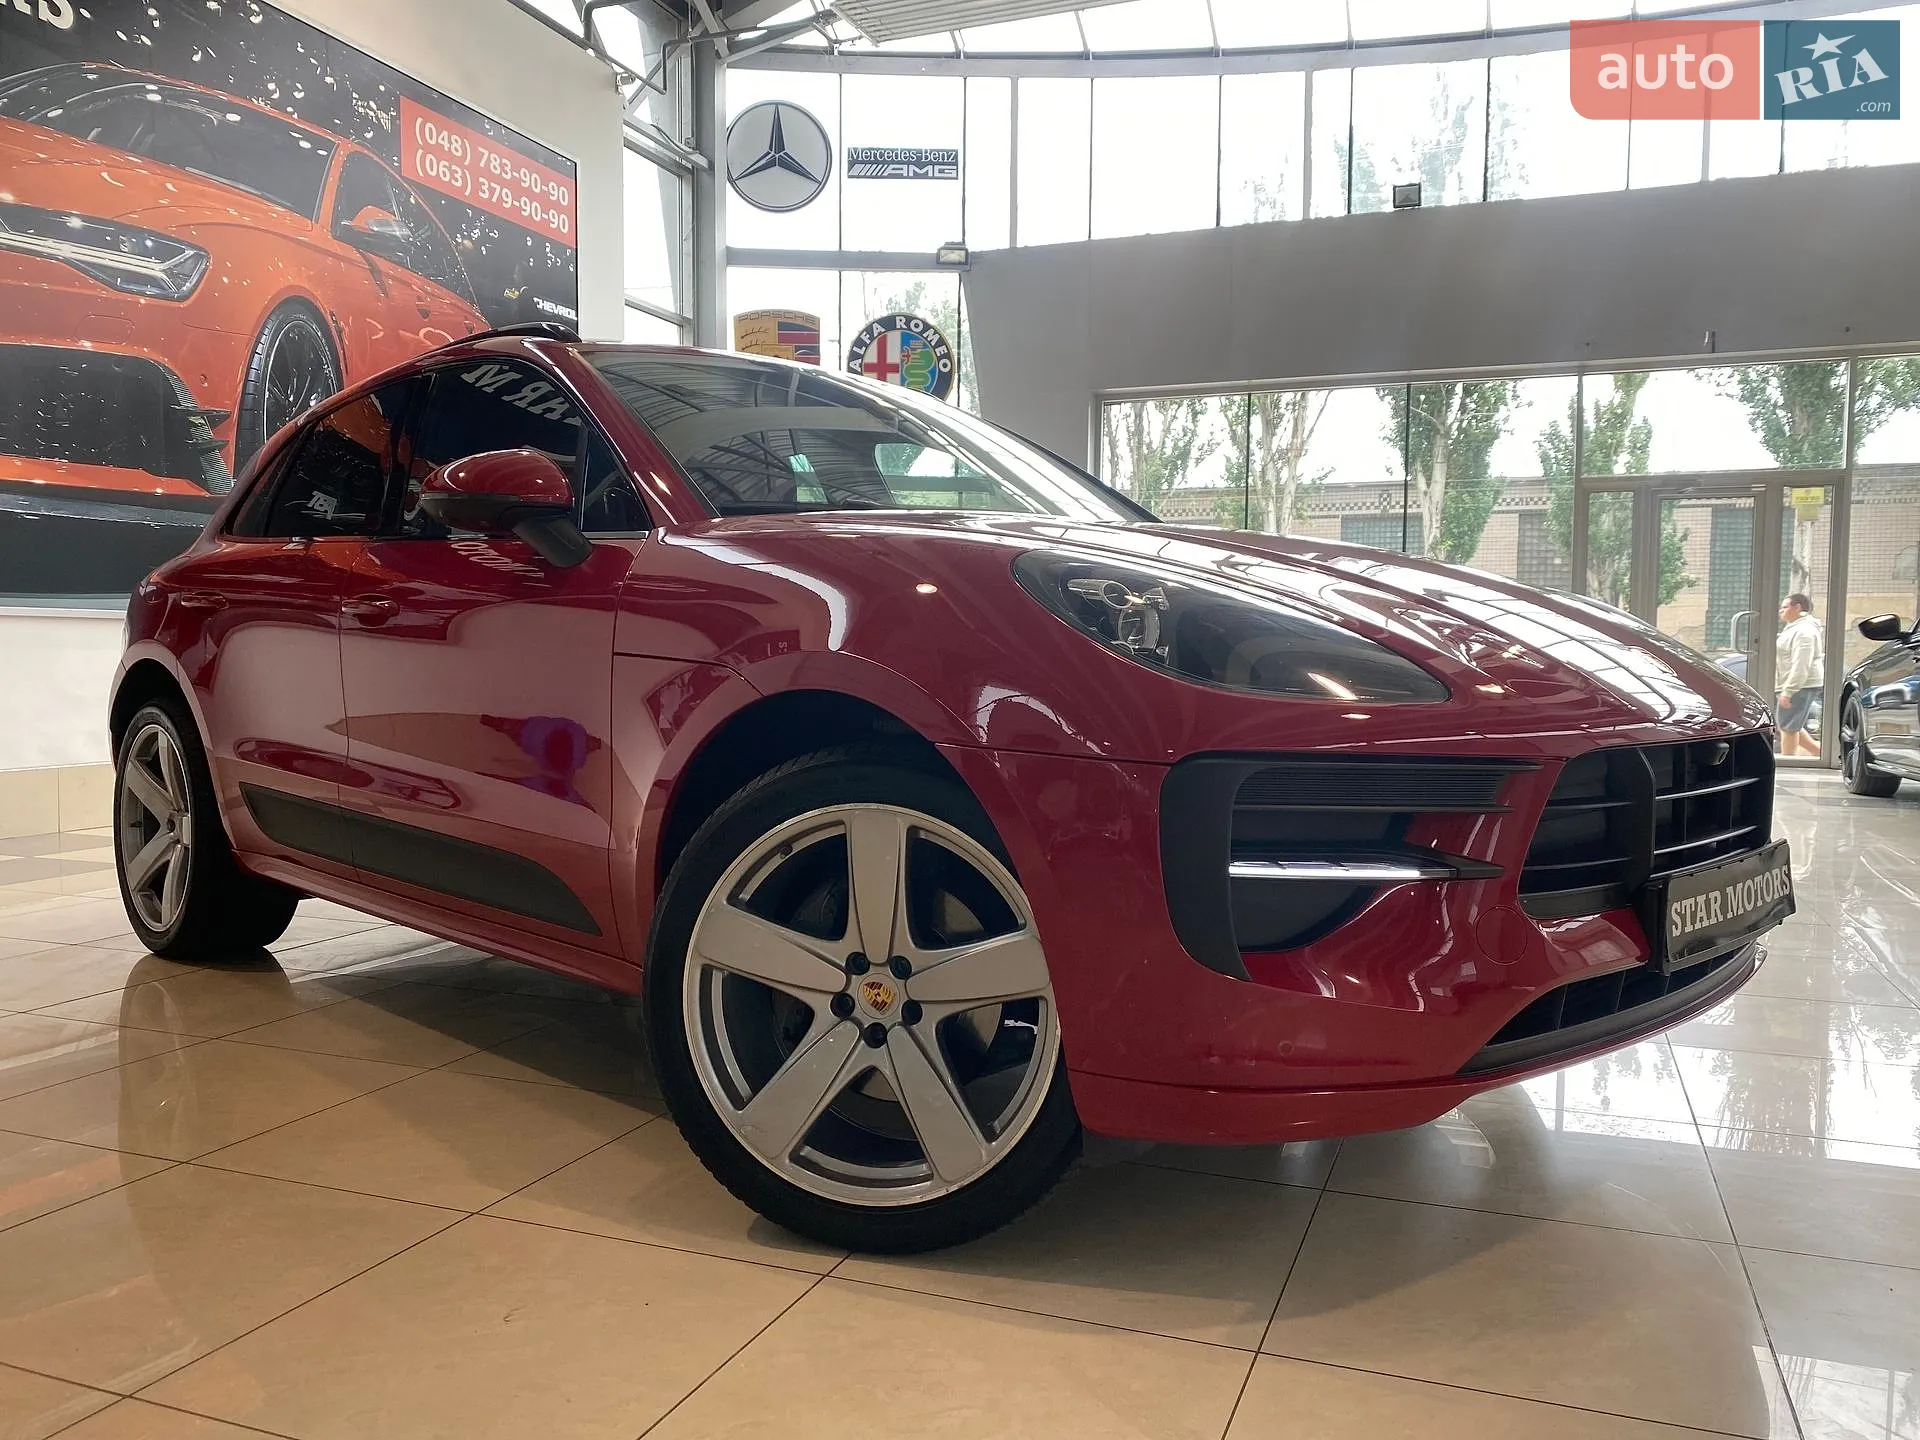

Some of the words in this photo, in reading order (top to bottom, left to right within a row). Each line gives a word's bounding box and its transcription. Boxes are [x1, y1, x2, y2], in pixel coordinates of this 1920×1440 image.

[415, 116, 472, 166] (048)
[478, 146, 569, 206] 783-90-90
[848, 147, 957, 163] Mercedes-Benz
[415, 149, 472, 197] (063)
[478, 177, 569, 234] 379-90-90
[738, 310, 816, 326] PORSCHE
[849, 322, 887, 371] ALFA
[895, 316, 952, 373] ROMEO
[1671, 890, 1723, 937] STAR
[1725, 865, 1790, 919] MOTORS
